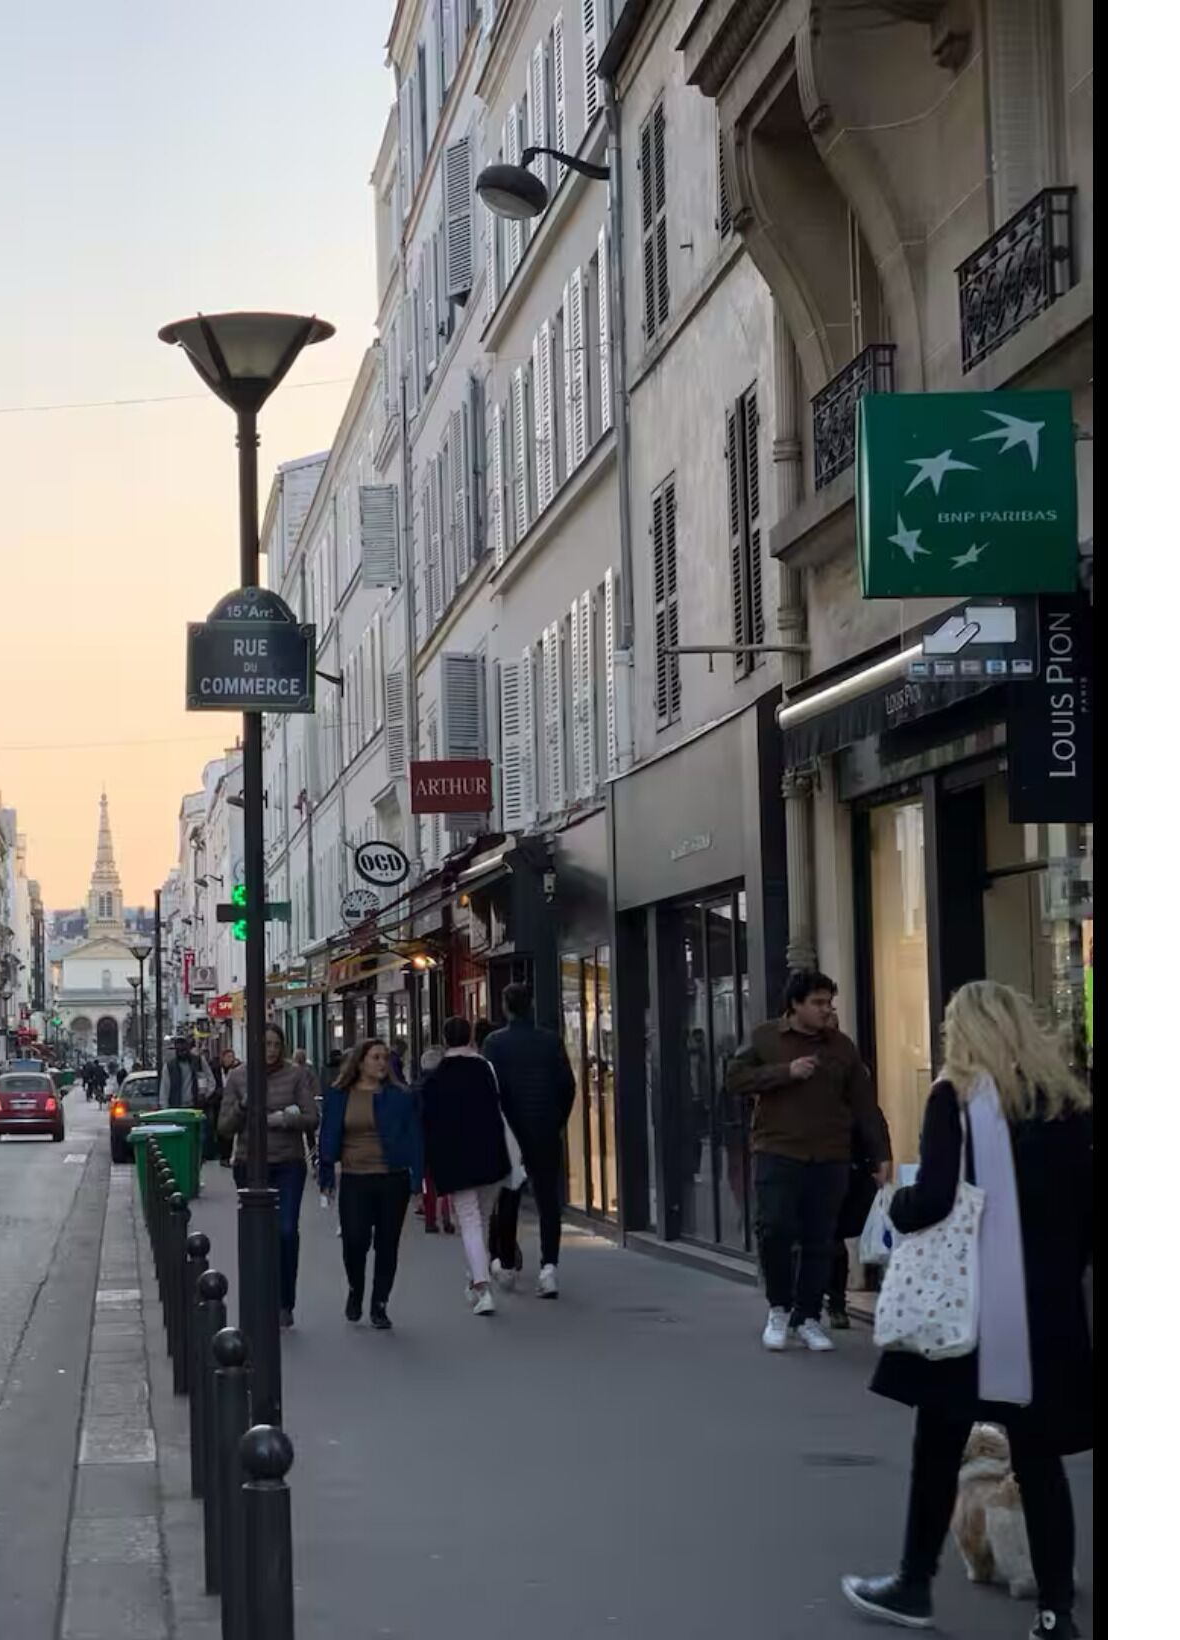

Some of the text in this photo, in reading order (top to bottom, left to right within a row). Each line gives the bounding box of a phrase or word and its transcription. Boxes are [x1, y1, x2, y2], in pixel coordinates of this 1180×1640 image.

[937, 510, 1058, 523] BNP PARIBAS
[233, 639, 268, 656] RUE
[244, 662, 257, 672] DU
[200, 678, 300, 695] COMMERCE
[1046, 613, 1076, 777] LOUIS PION
[416, 777, 488, 796] ARTHUR
